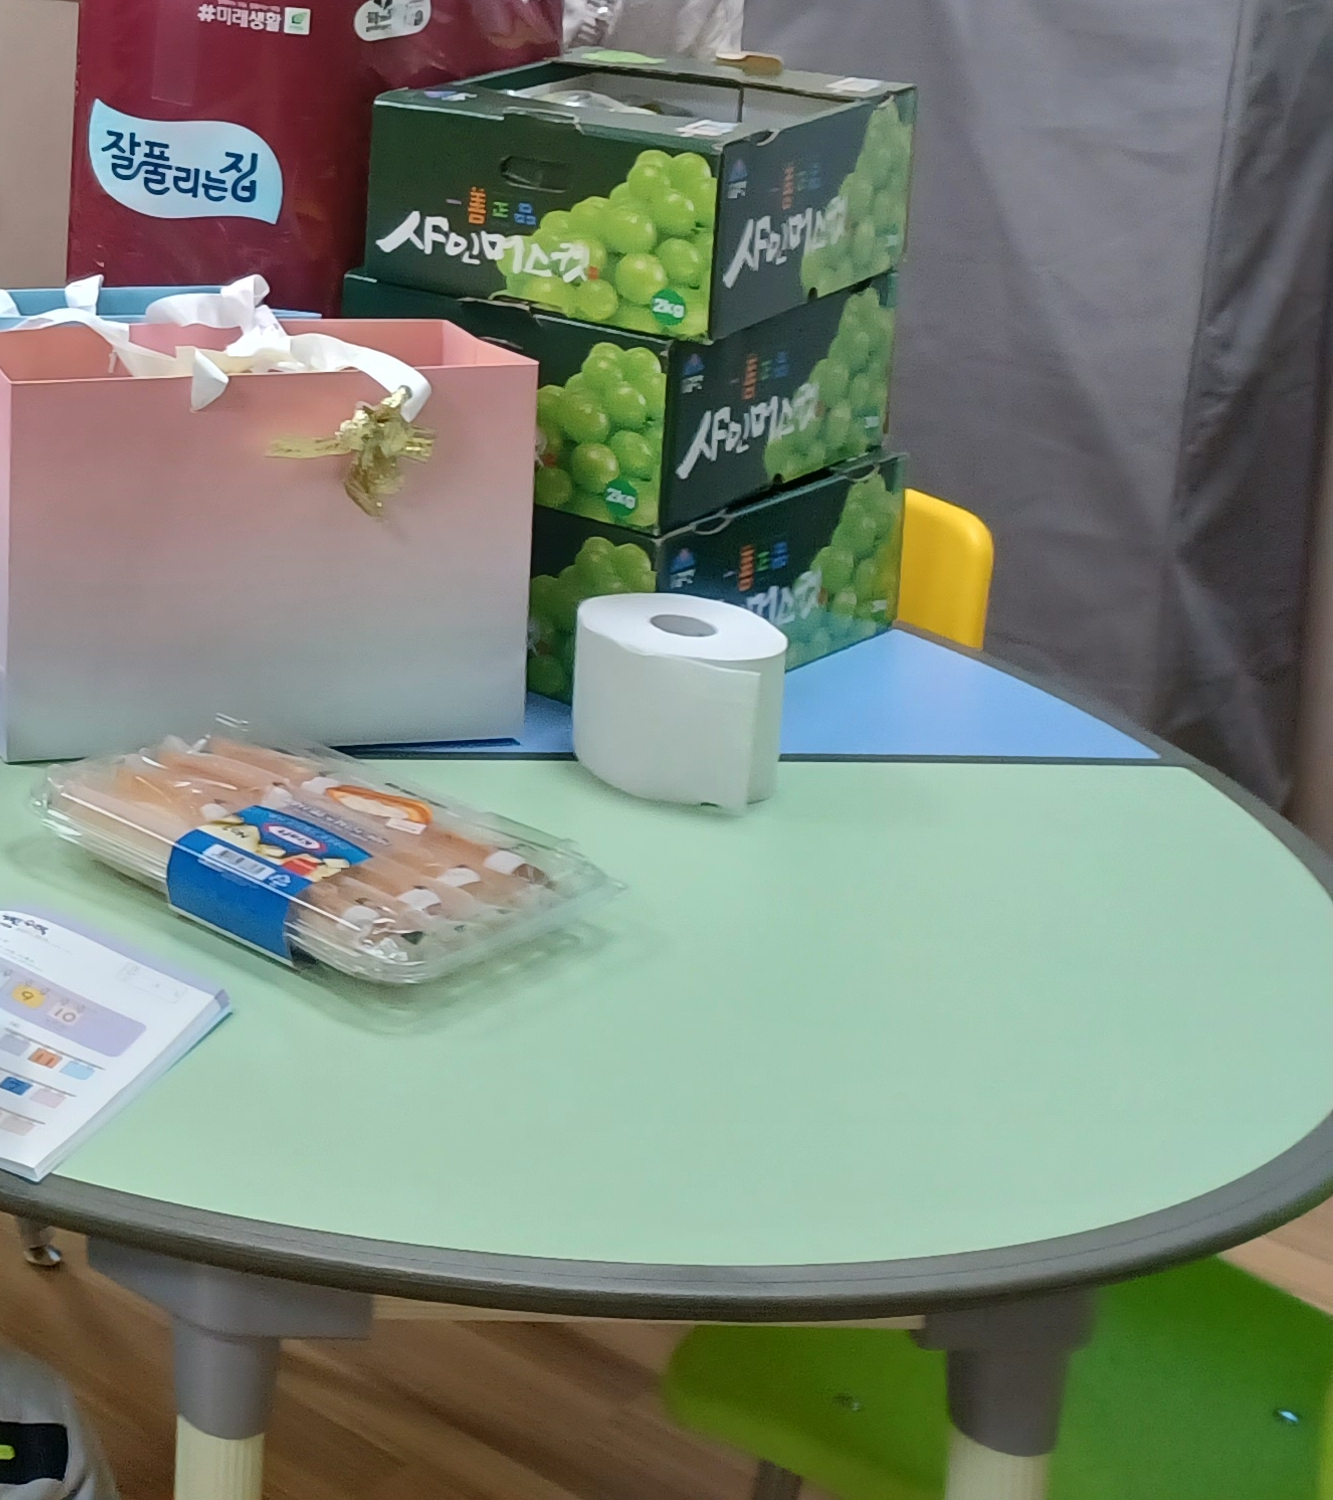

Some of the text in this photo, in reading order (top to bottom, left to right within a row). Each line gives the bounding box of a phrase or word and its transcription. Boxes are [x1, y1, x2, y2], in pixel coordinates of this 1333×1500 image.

[198, 3, 282, 33] #미래생활
[101, 129, 258, 203] 잘풀리는집
[653, 297, 685, 318] 2kg
[605, 486, 637, 509] 2kg
[20, 990, 35, 1002] 9
[53, 1007, 78, 1024] 10
